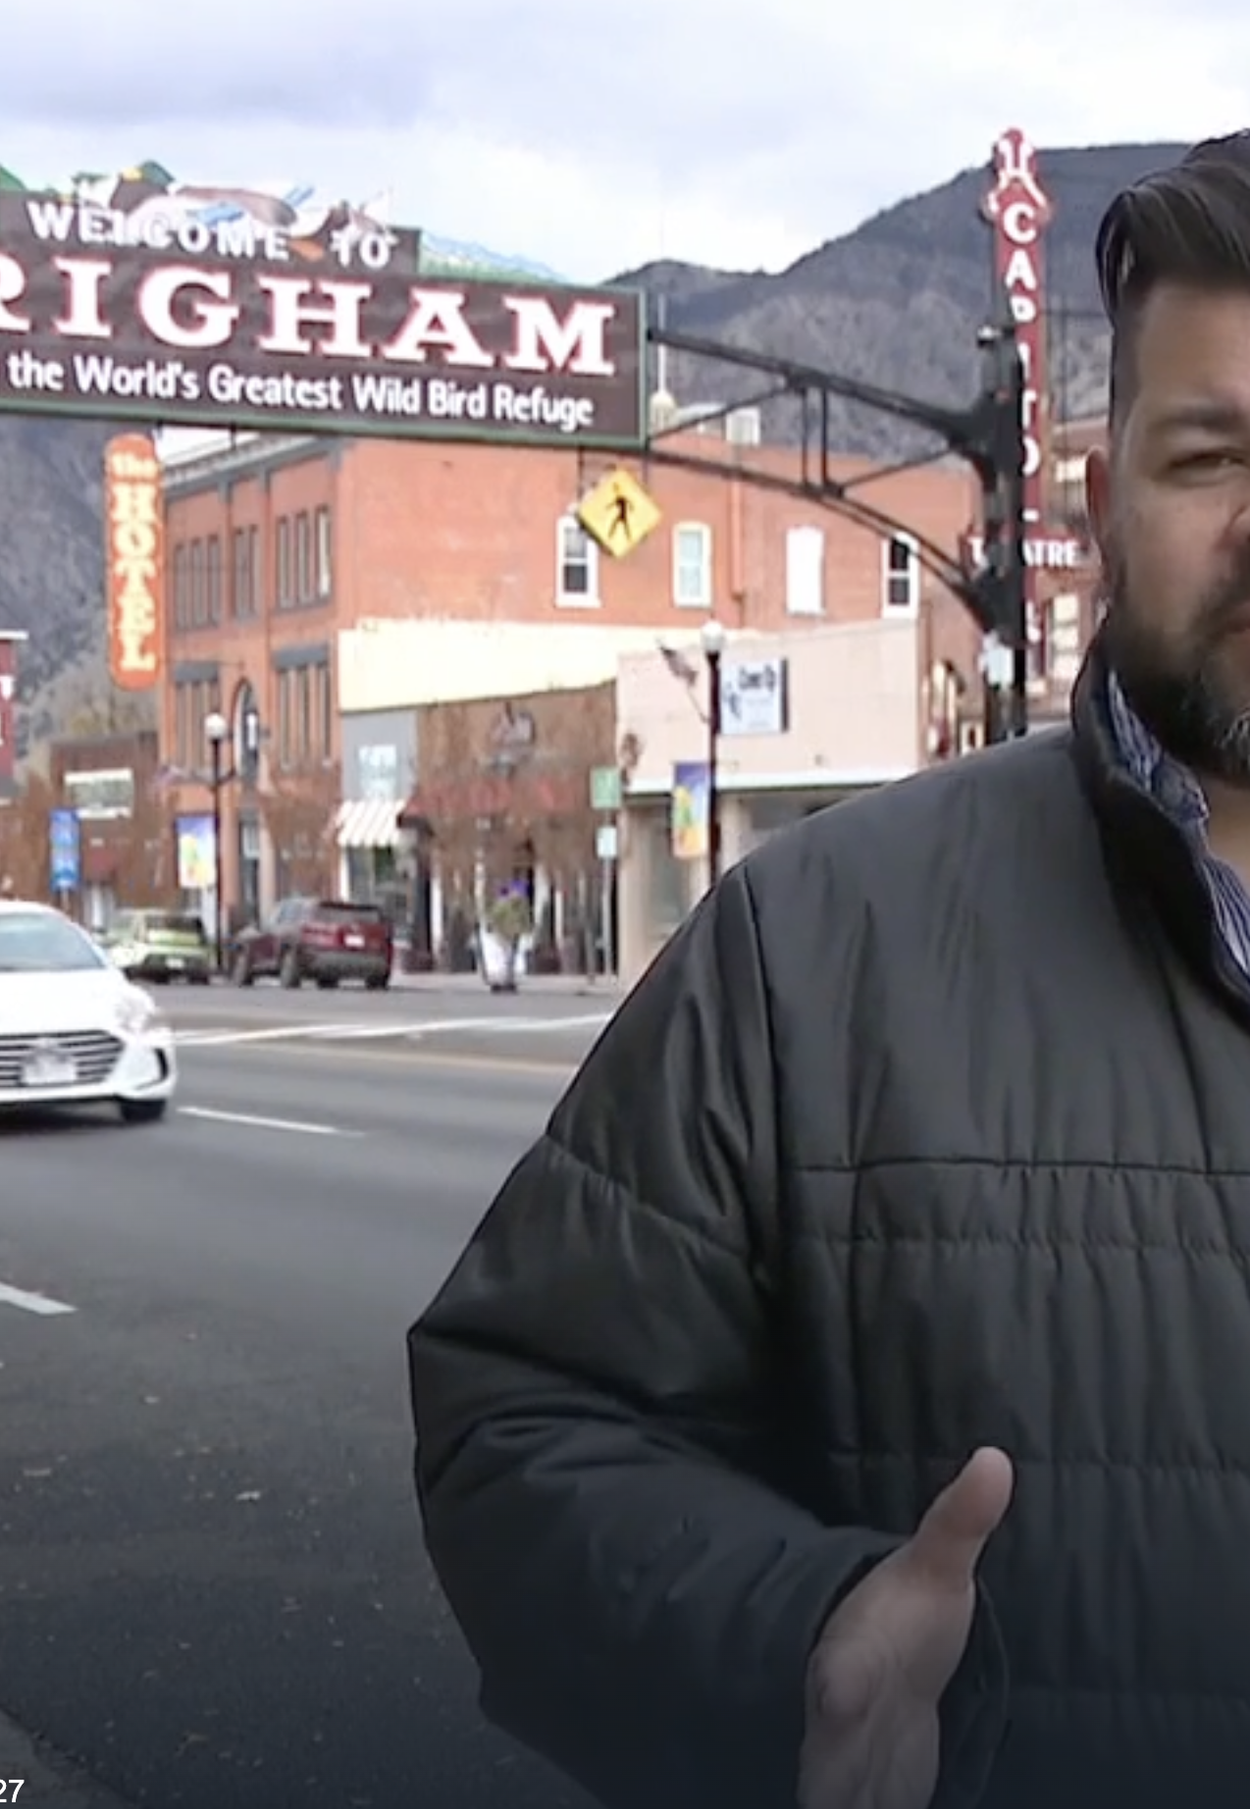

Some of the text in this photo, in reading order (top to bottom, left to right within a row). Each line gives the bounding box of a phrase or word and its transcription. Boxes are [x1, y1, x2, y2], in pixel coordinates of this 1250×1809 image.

[26, 200, 391, 268] WELCOME TO
[7, 350, 595, 432] the World's Greatest Wild Bird Refuge
[112, 481, 157, 672] HOTEL
